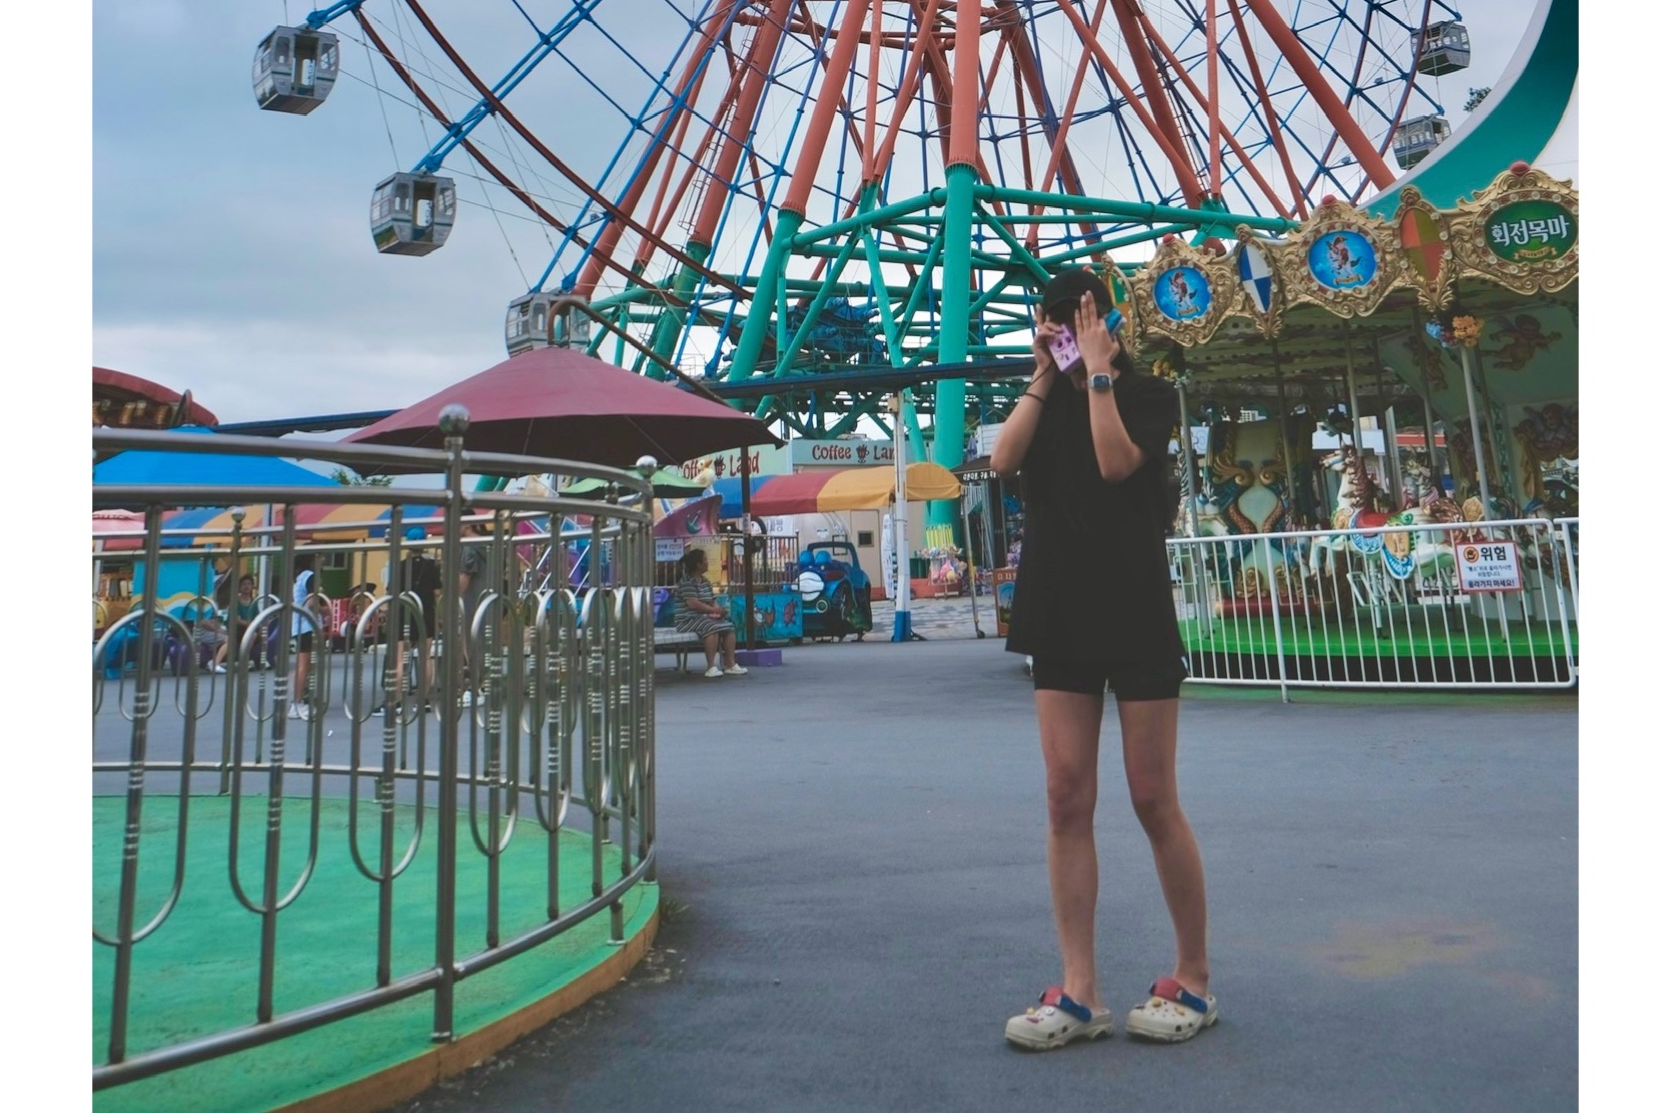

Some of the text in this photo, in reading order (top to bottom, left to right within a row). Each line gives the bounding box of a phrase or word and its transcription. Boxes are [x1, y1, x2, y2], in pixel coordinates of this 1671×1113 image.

[1491, 215, 1570, 246] 회전목마
[812, 444, 896, 460] Coffee Lan
[1480, 547, 1507, 561] 위험
[1468, 580, 1492, 588] 올라가지
